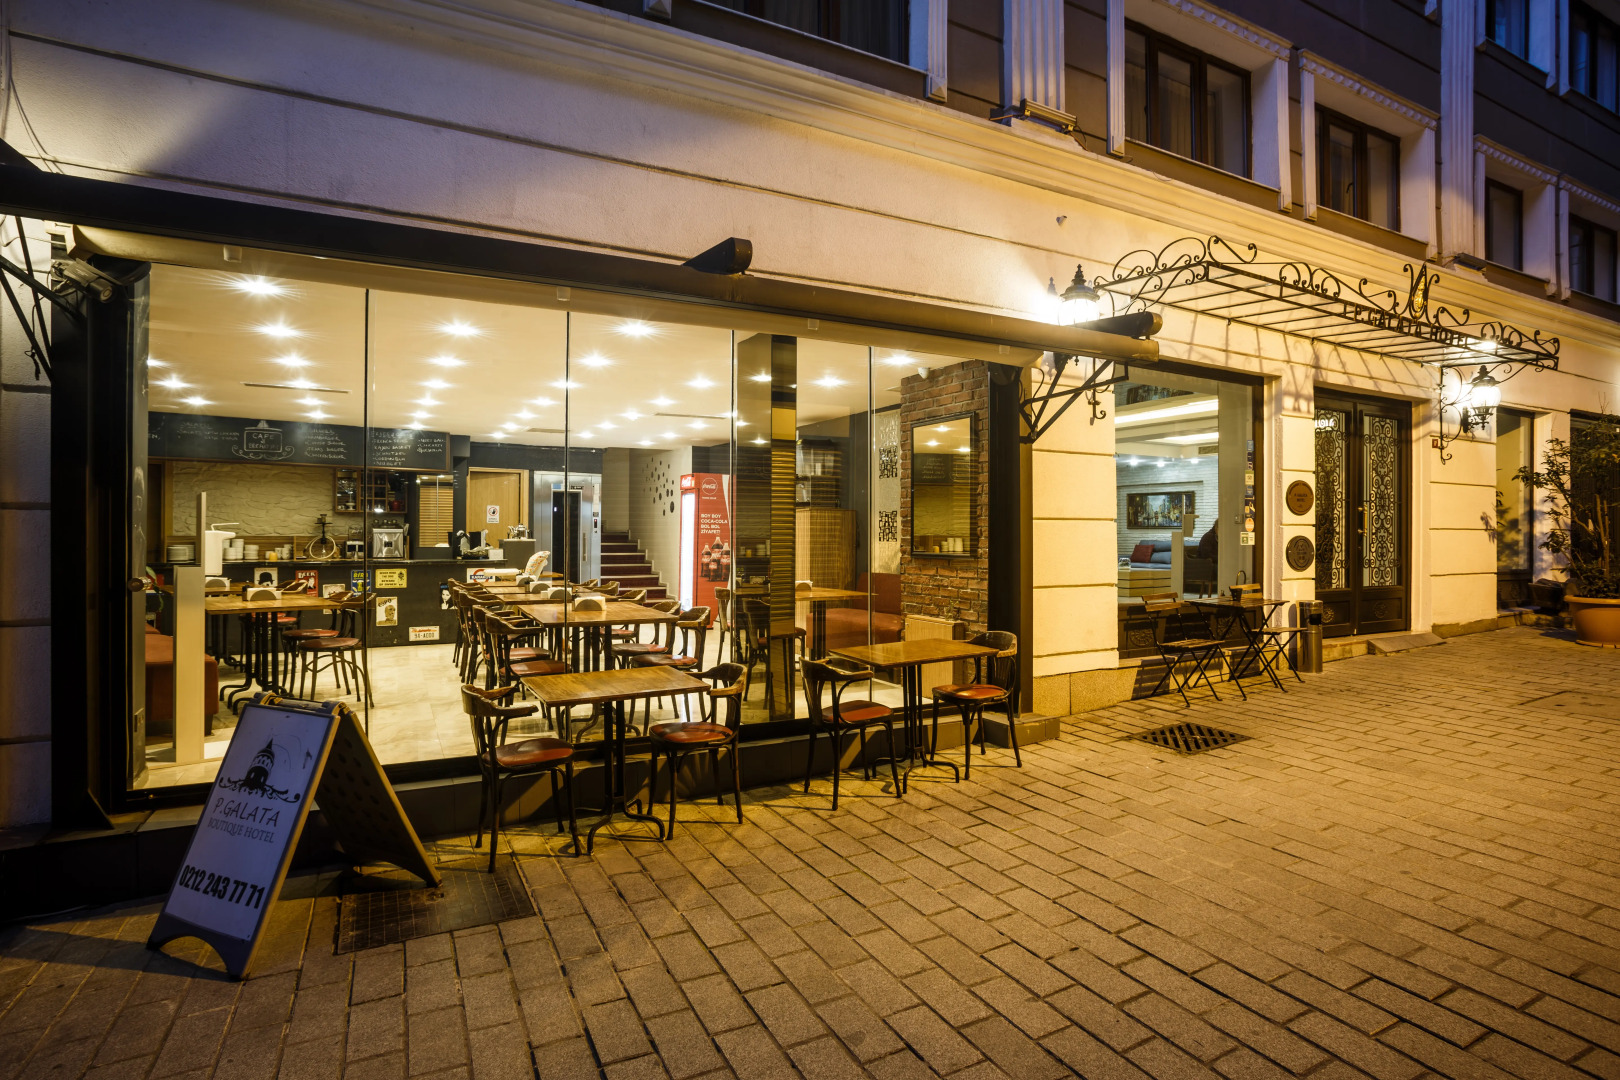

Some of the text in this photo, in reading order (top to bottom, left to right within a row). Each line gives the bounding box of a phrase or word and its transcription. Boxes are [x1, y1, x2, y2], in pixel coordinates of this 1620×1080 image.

[213, 797, 281, 827] P.GALATA
[207, 817, 275, 843] BOUTIQUE HOTEL
[179, 865, 266, 909] 0212 243 77 71
